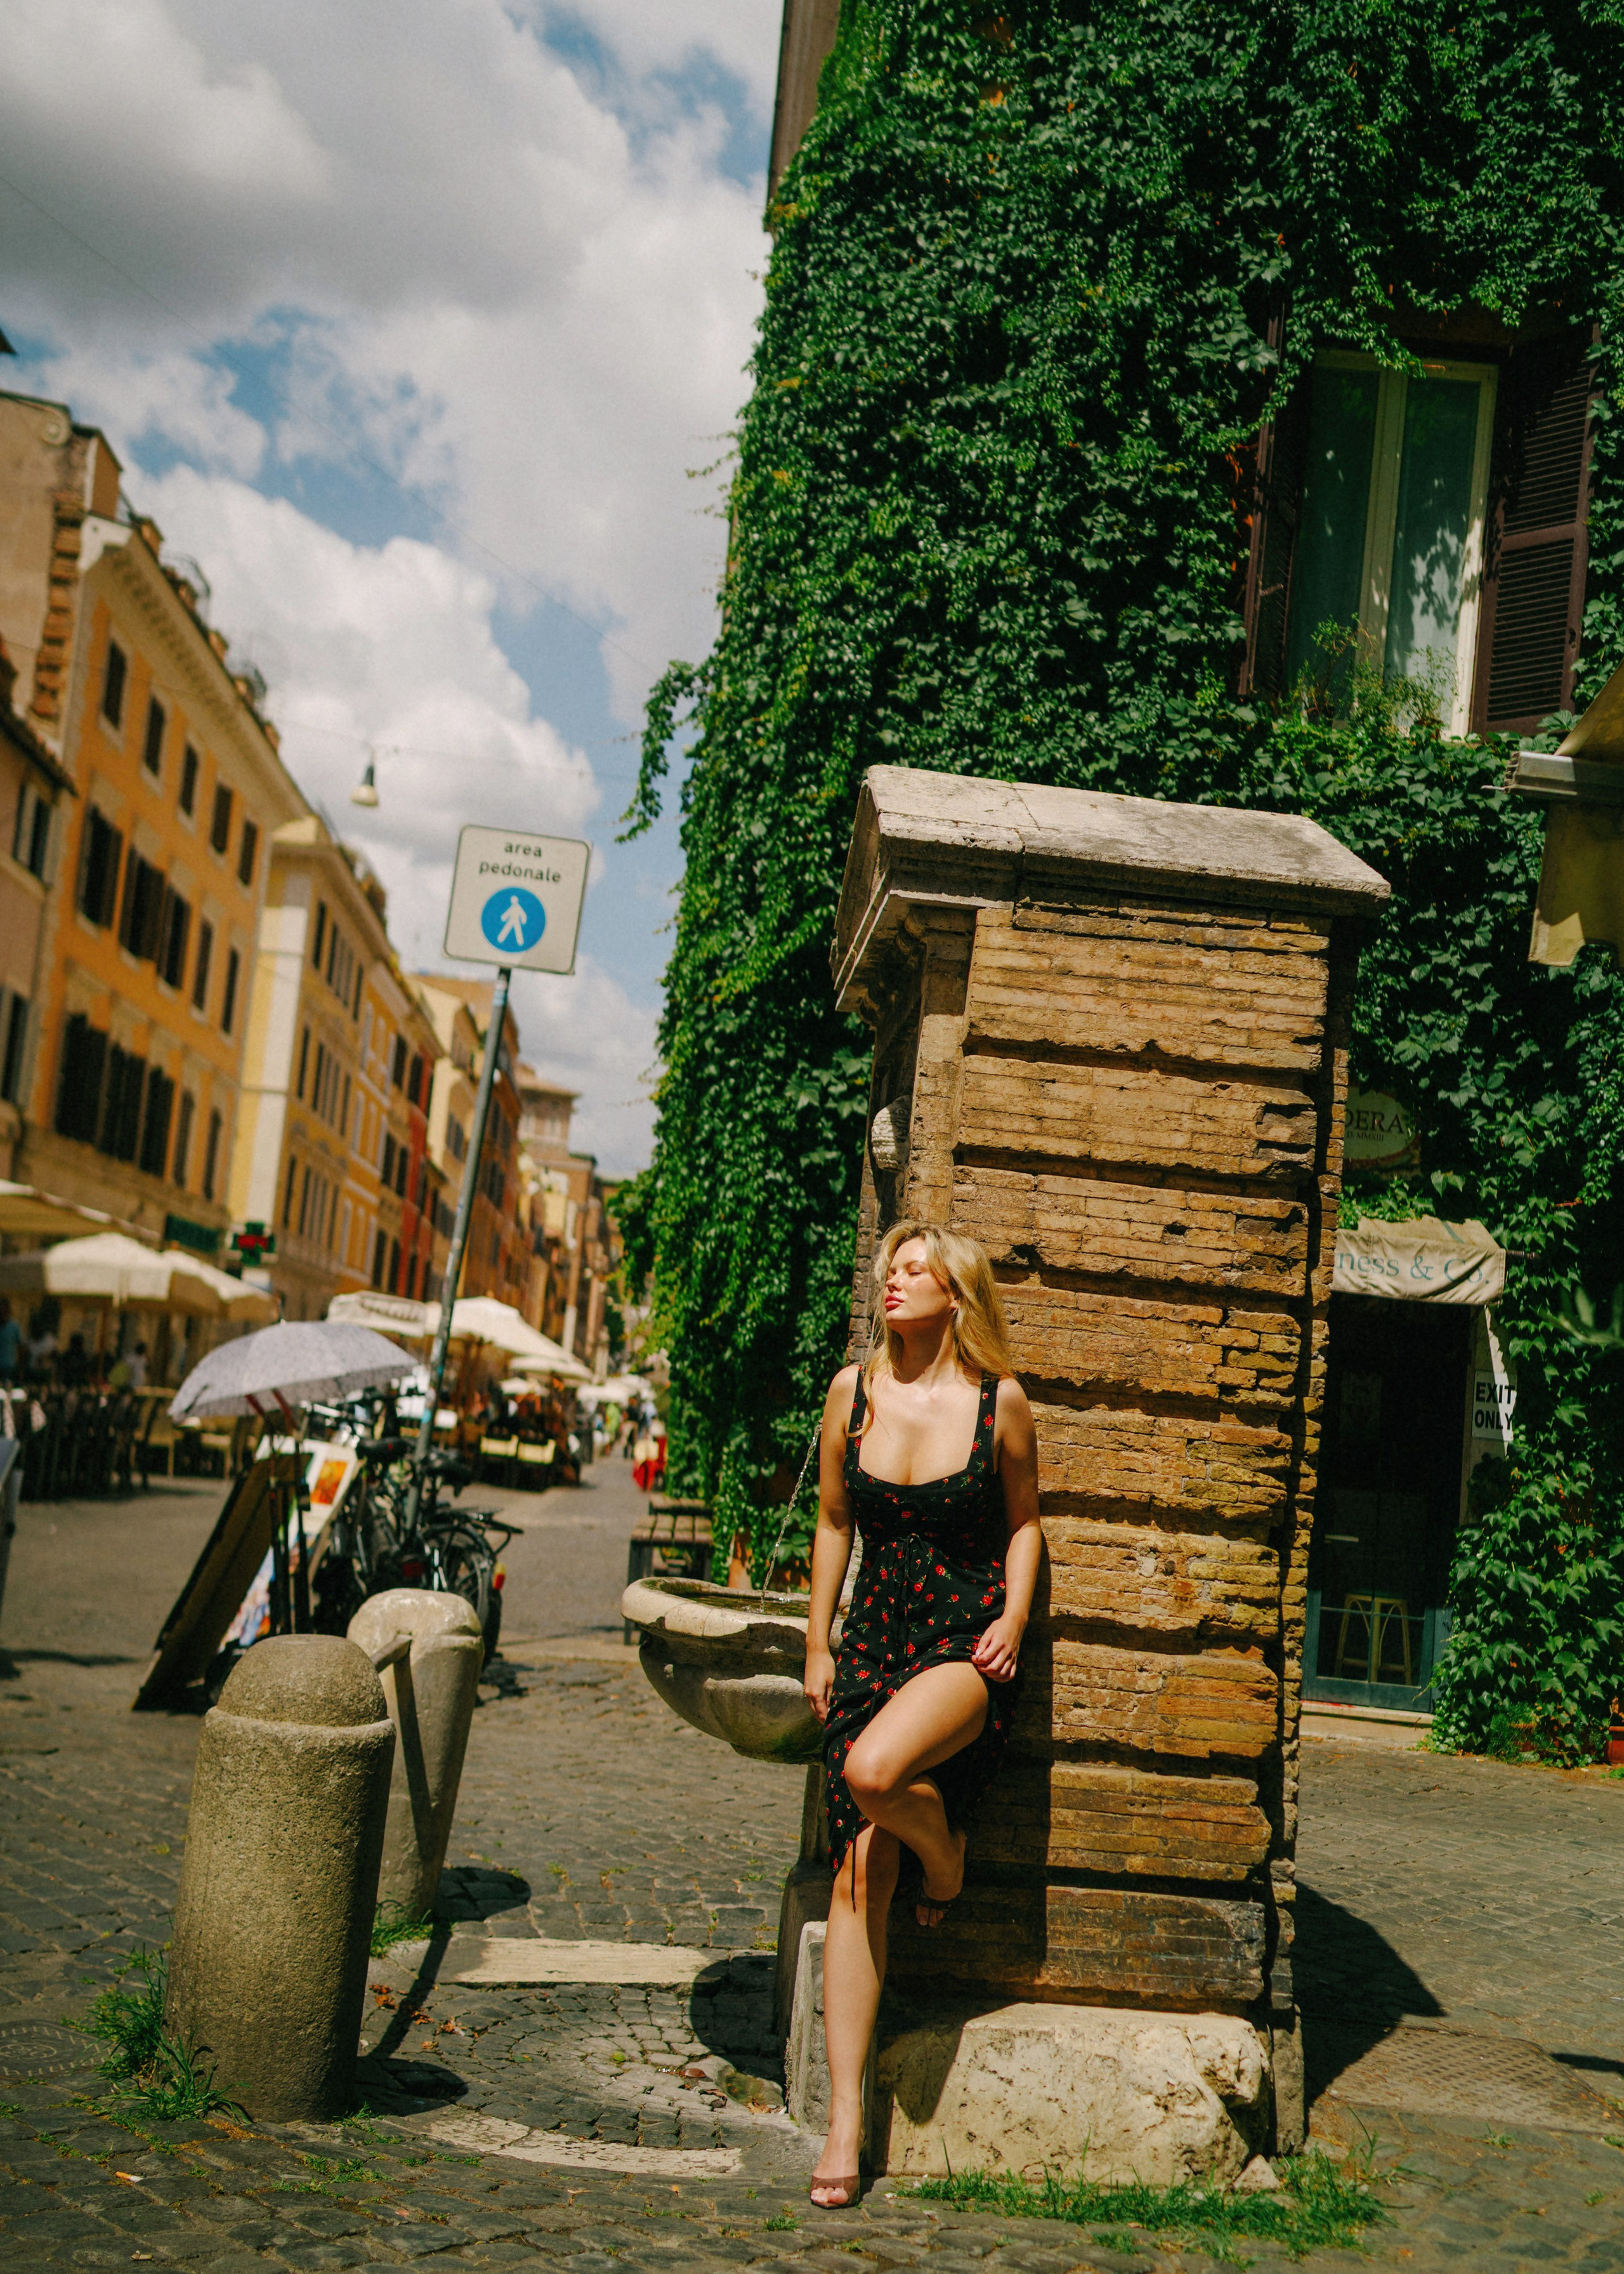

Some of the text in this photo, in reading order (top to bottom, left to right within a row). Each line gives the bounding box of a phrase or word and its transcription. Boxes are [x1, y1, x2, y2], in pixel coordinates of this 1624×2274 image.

[504, 842, 542, 857] area
[479, 861, 561, 883] pedonale
[1410, 1255, 1434, 1280] &
[1475, 1381, 1516, 1404] EXIT
[1474, 1409, 1514, 1430] ONLY
